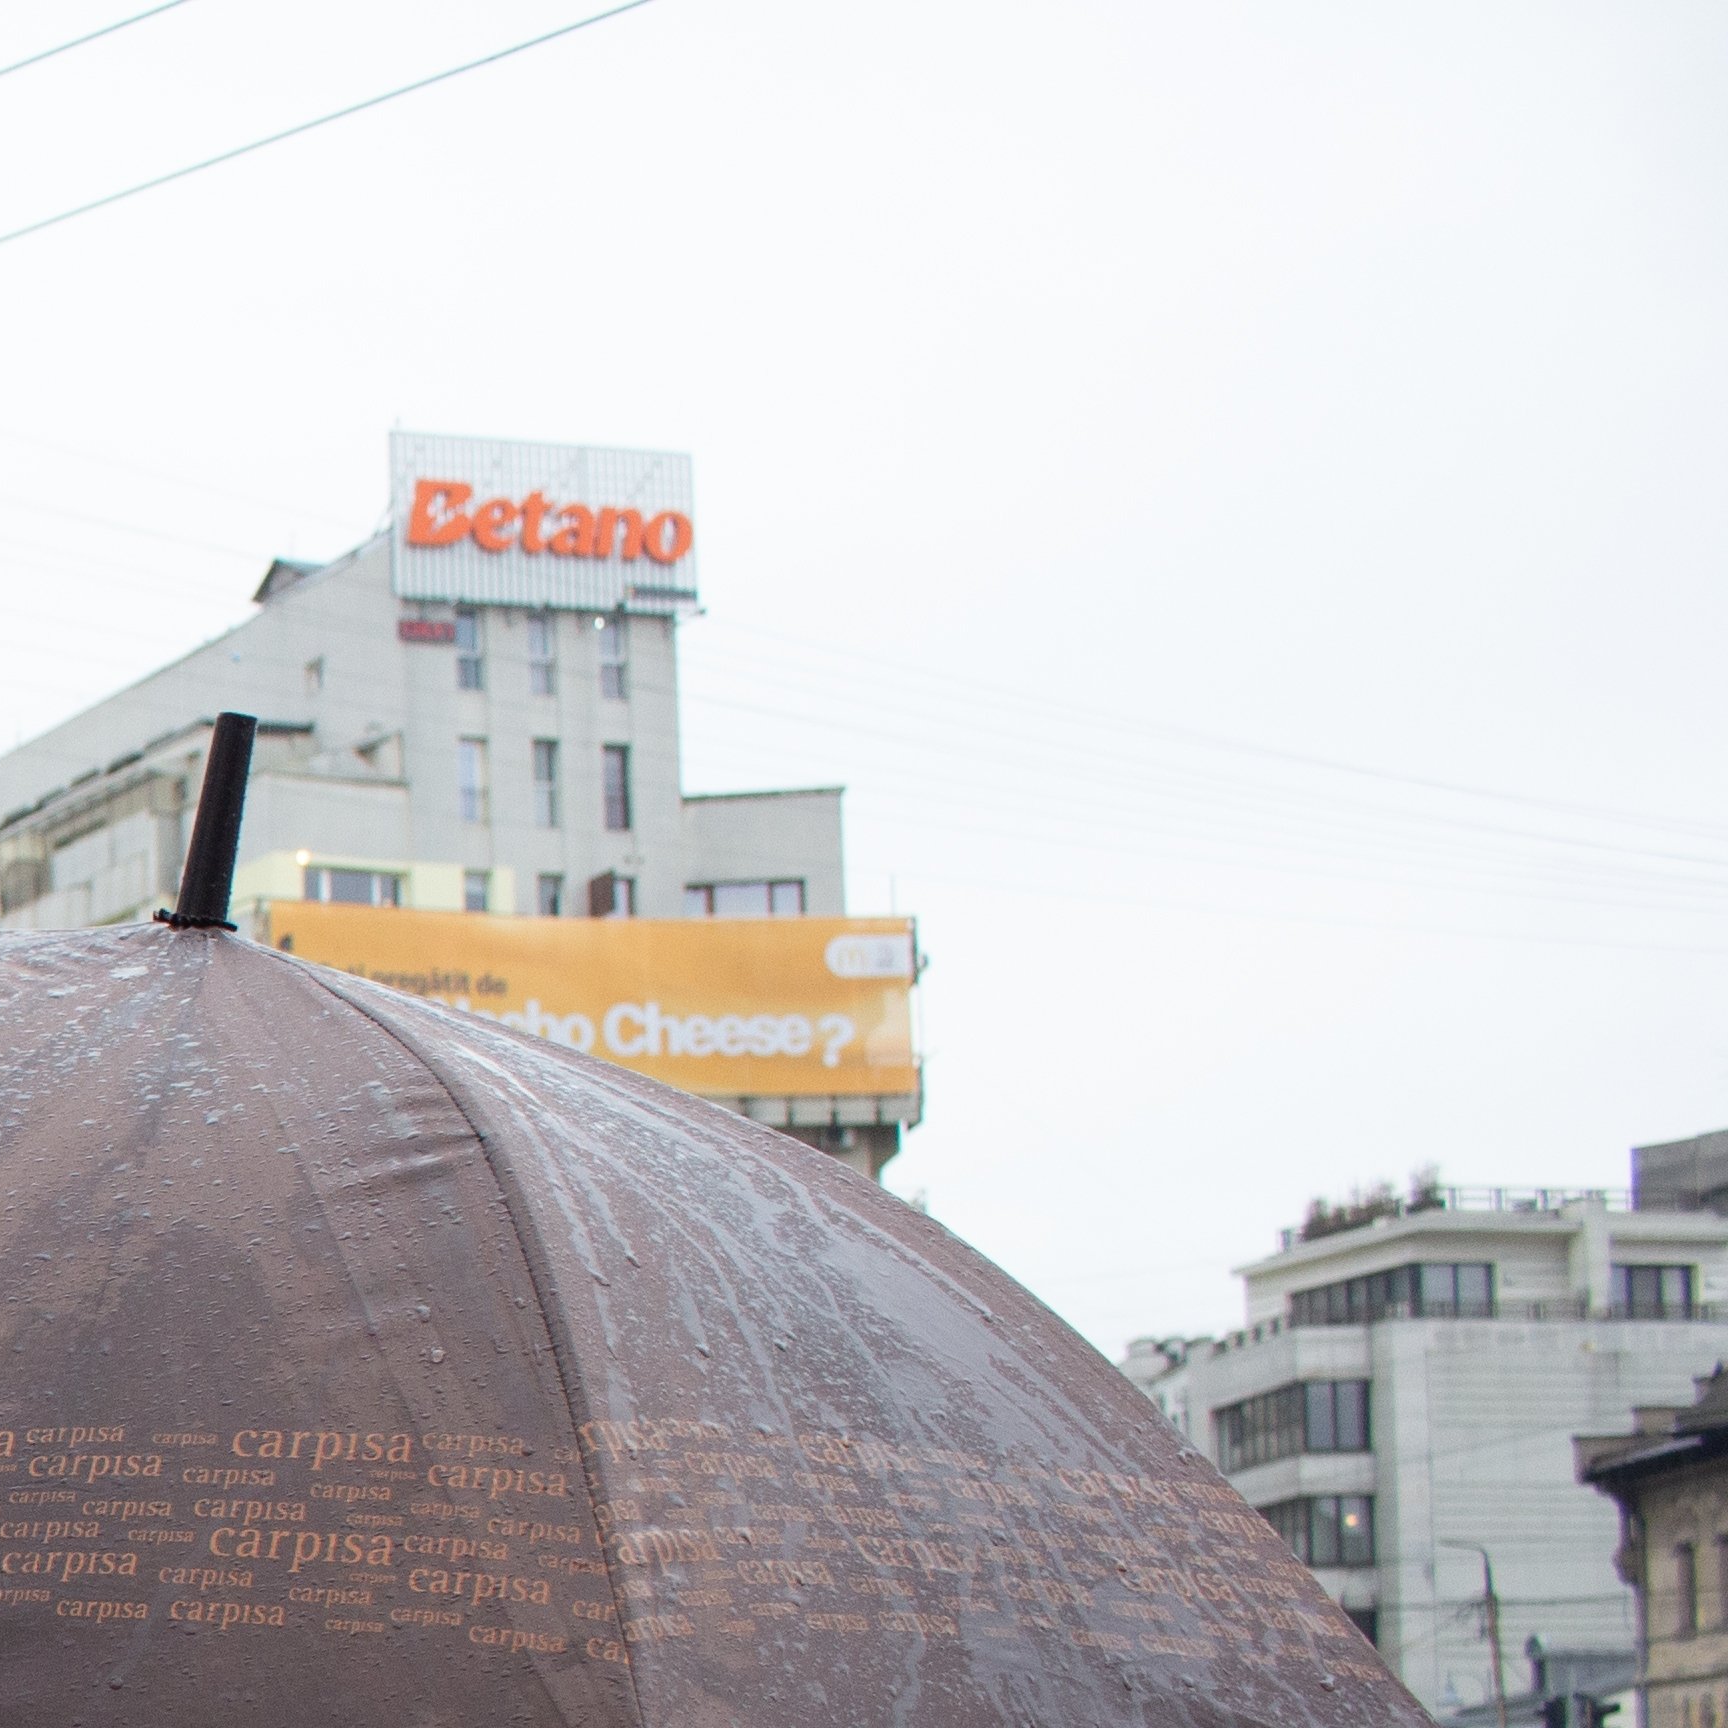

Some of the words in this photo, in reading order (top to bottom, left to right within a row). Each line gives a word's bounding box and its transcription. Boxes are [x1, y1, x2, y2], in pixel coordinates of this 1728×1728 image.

[408, 479, 694, 565] Betano
[232, 1429, 414, 1471] carpisa
[28, 1453, 163, 1485] carpisa
[428, 1464, 568, 1499] carpisa
[1, 1551, 138, 1583] carpisa
[209, 1525, 394, 1573] carpisa
[408, 1568, 551, 1607] carpisa
[169, 1600, 287, 1631] carpisa
